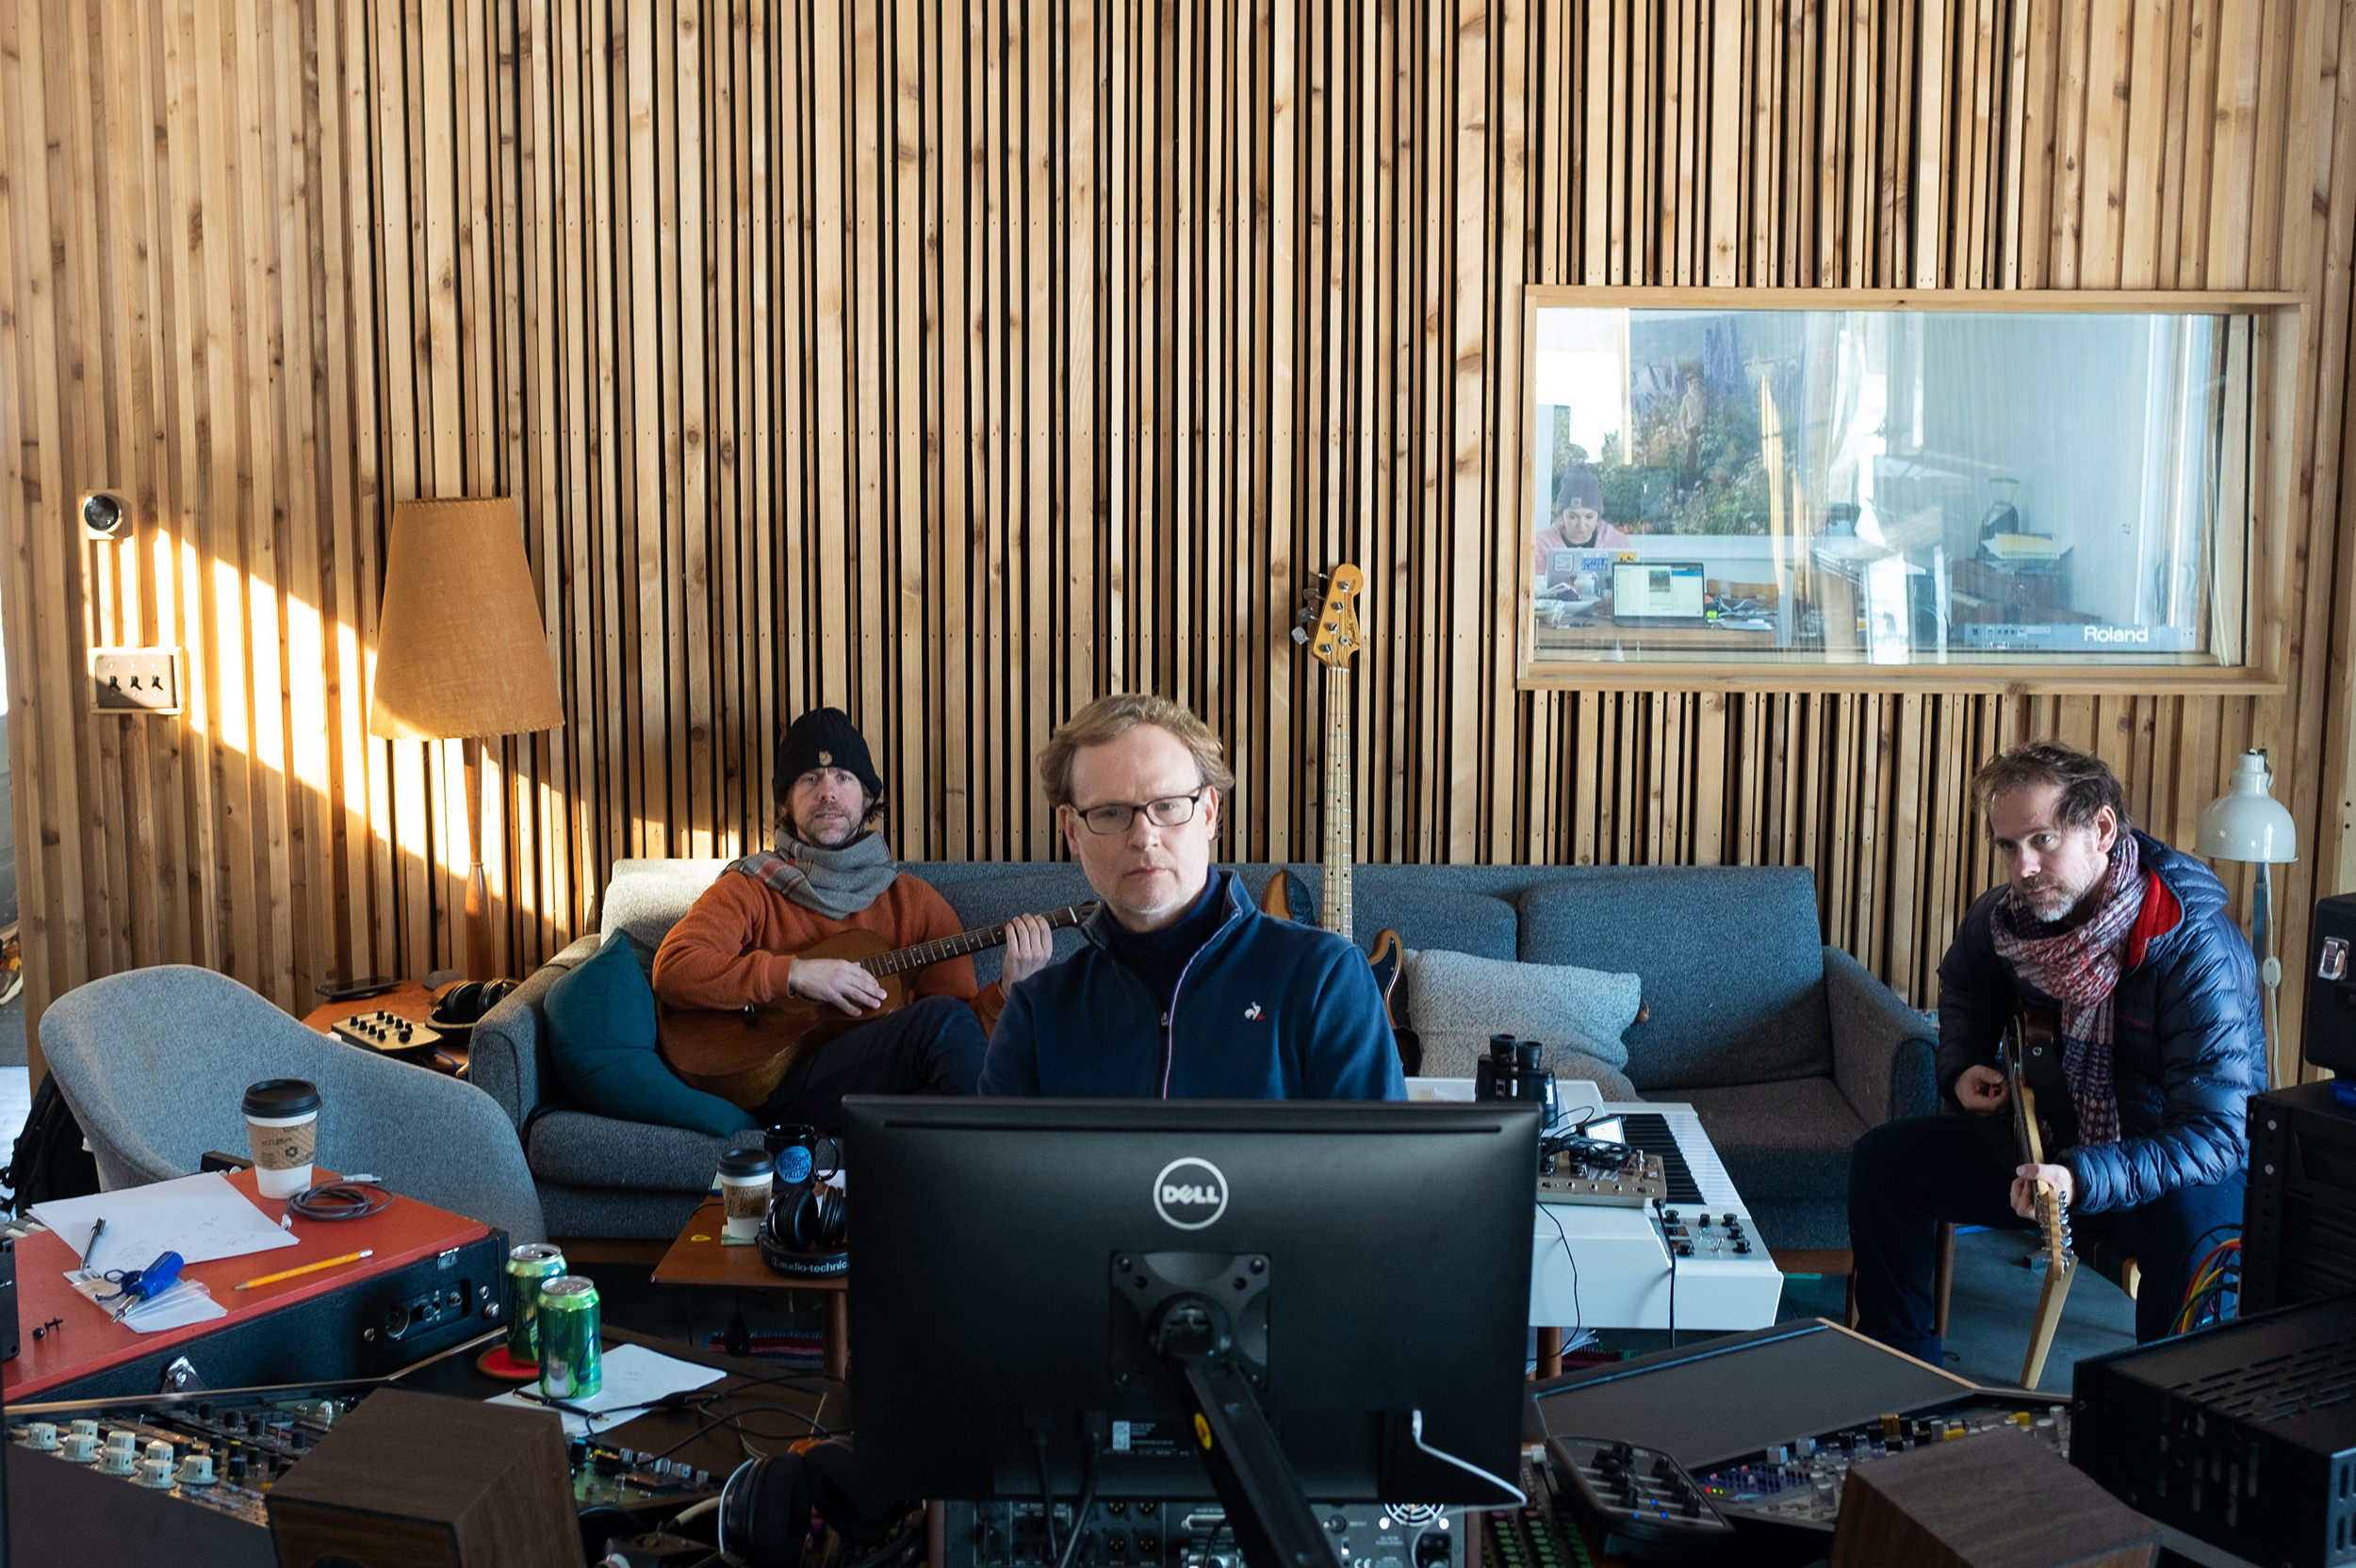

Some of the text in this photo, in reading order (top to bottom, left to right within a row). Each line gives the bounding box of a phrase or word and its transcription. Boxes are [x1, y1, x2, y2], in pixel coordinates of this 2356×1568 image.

[2084, 626, 2149, 643] Roland
[1162, 1184, 1220, 1204] DELL
[779, 1260, 849, 1273] audio-technic
